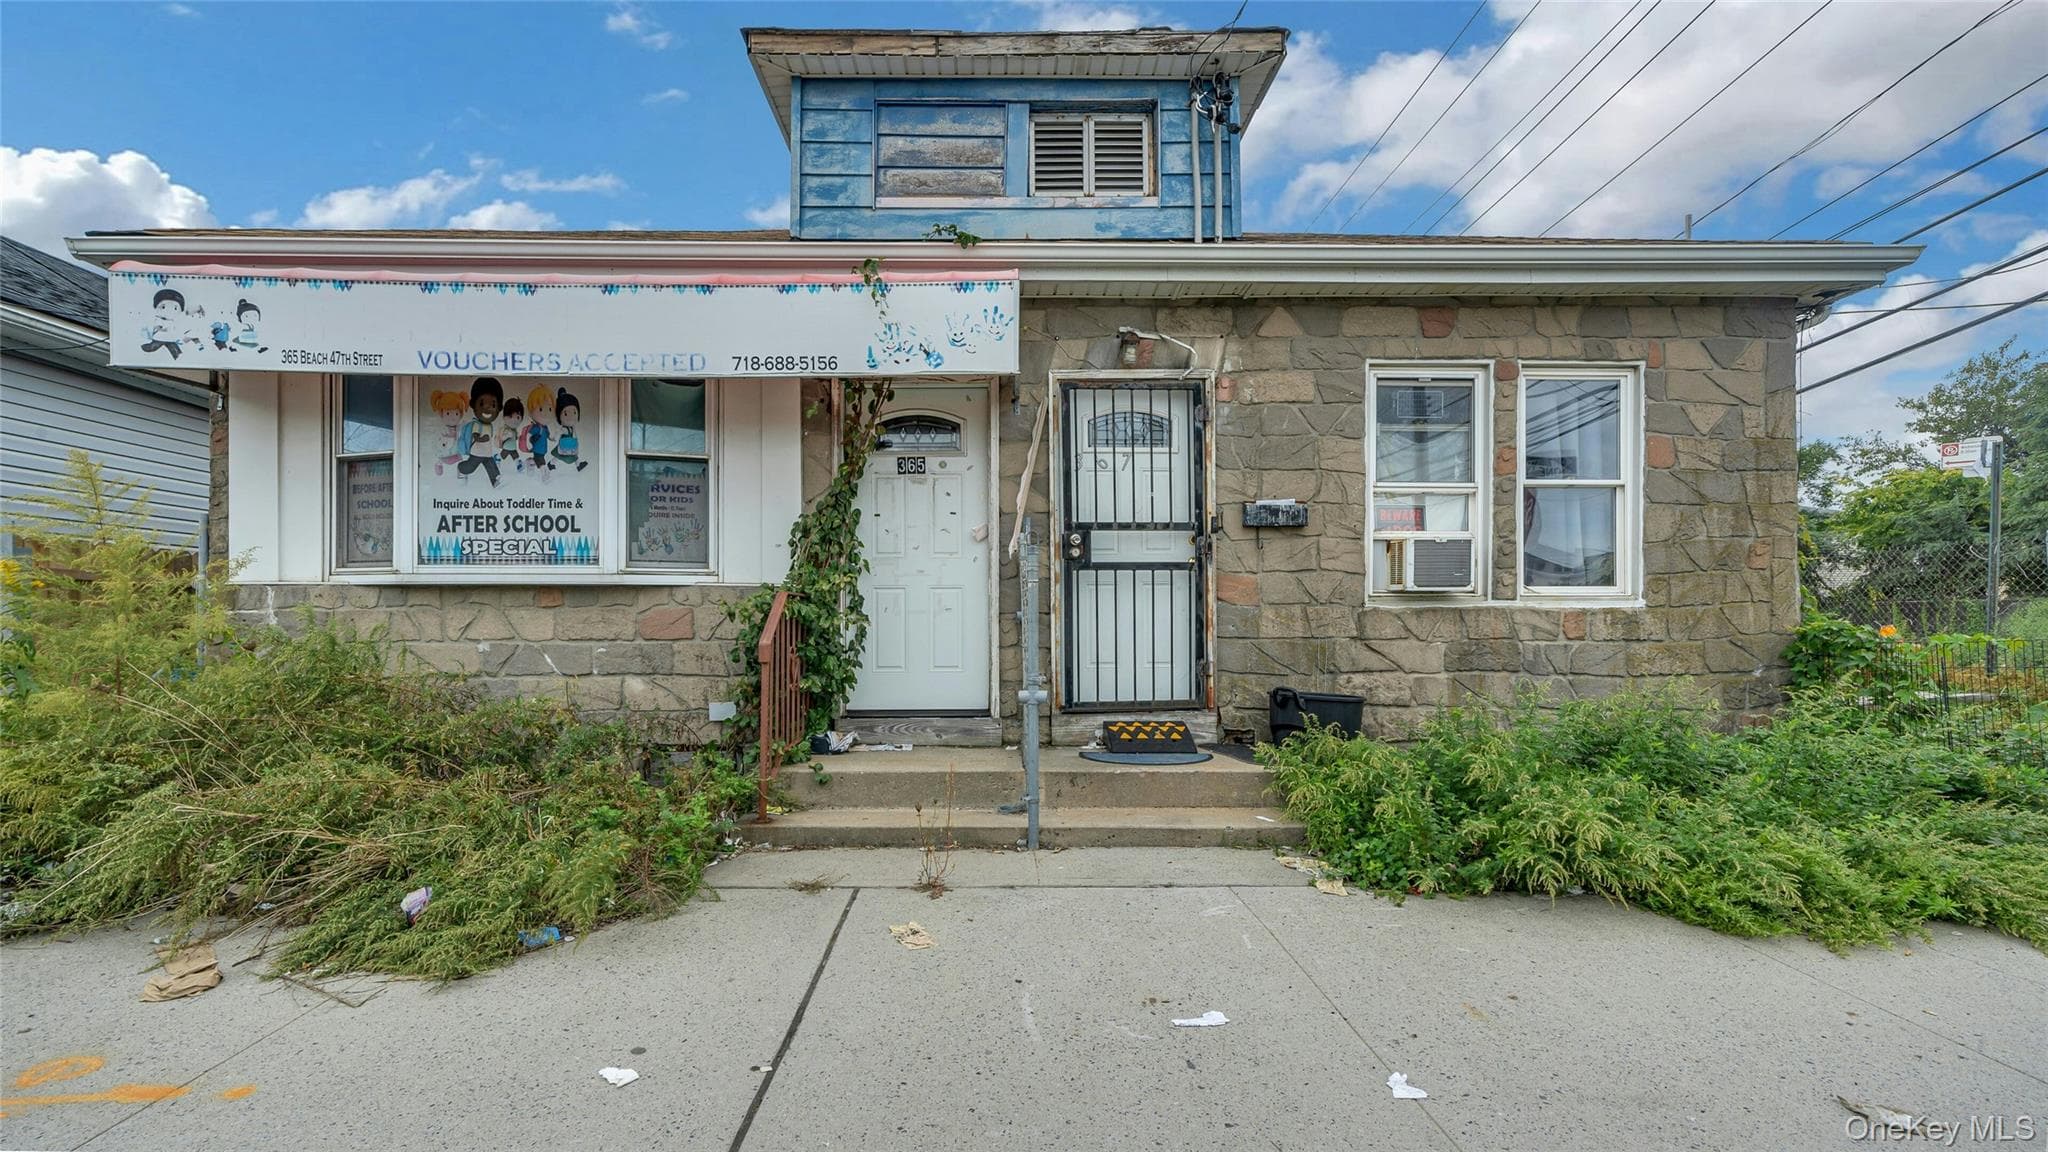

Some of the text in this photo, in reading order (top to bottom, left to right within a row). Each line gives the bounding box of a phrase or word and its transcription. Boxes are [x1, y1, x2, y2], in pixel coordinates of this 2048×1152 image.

[281, 349, 298, 364] 365
[417, 350, 707, 373] VOUCHERS ACCEPTED
[731, 355, 838, 371] 718-688-5156
[898, 458, 925, 473] 365
[357, 499, 393, 510] SCHOOL
[433, 498, 584, 511] Inquire About Toddler Time &
[437, 514, 581, 533] AFTER SCHOOL
[461, 538, 558, 556] SPECIAL
